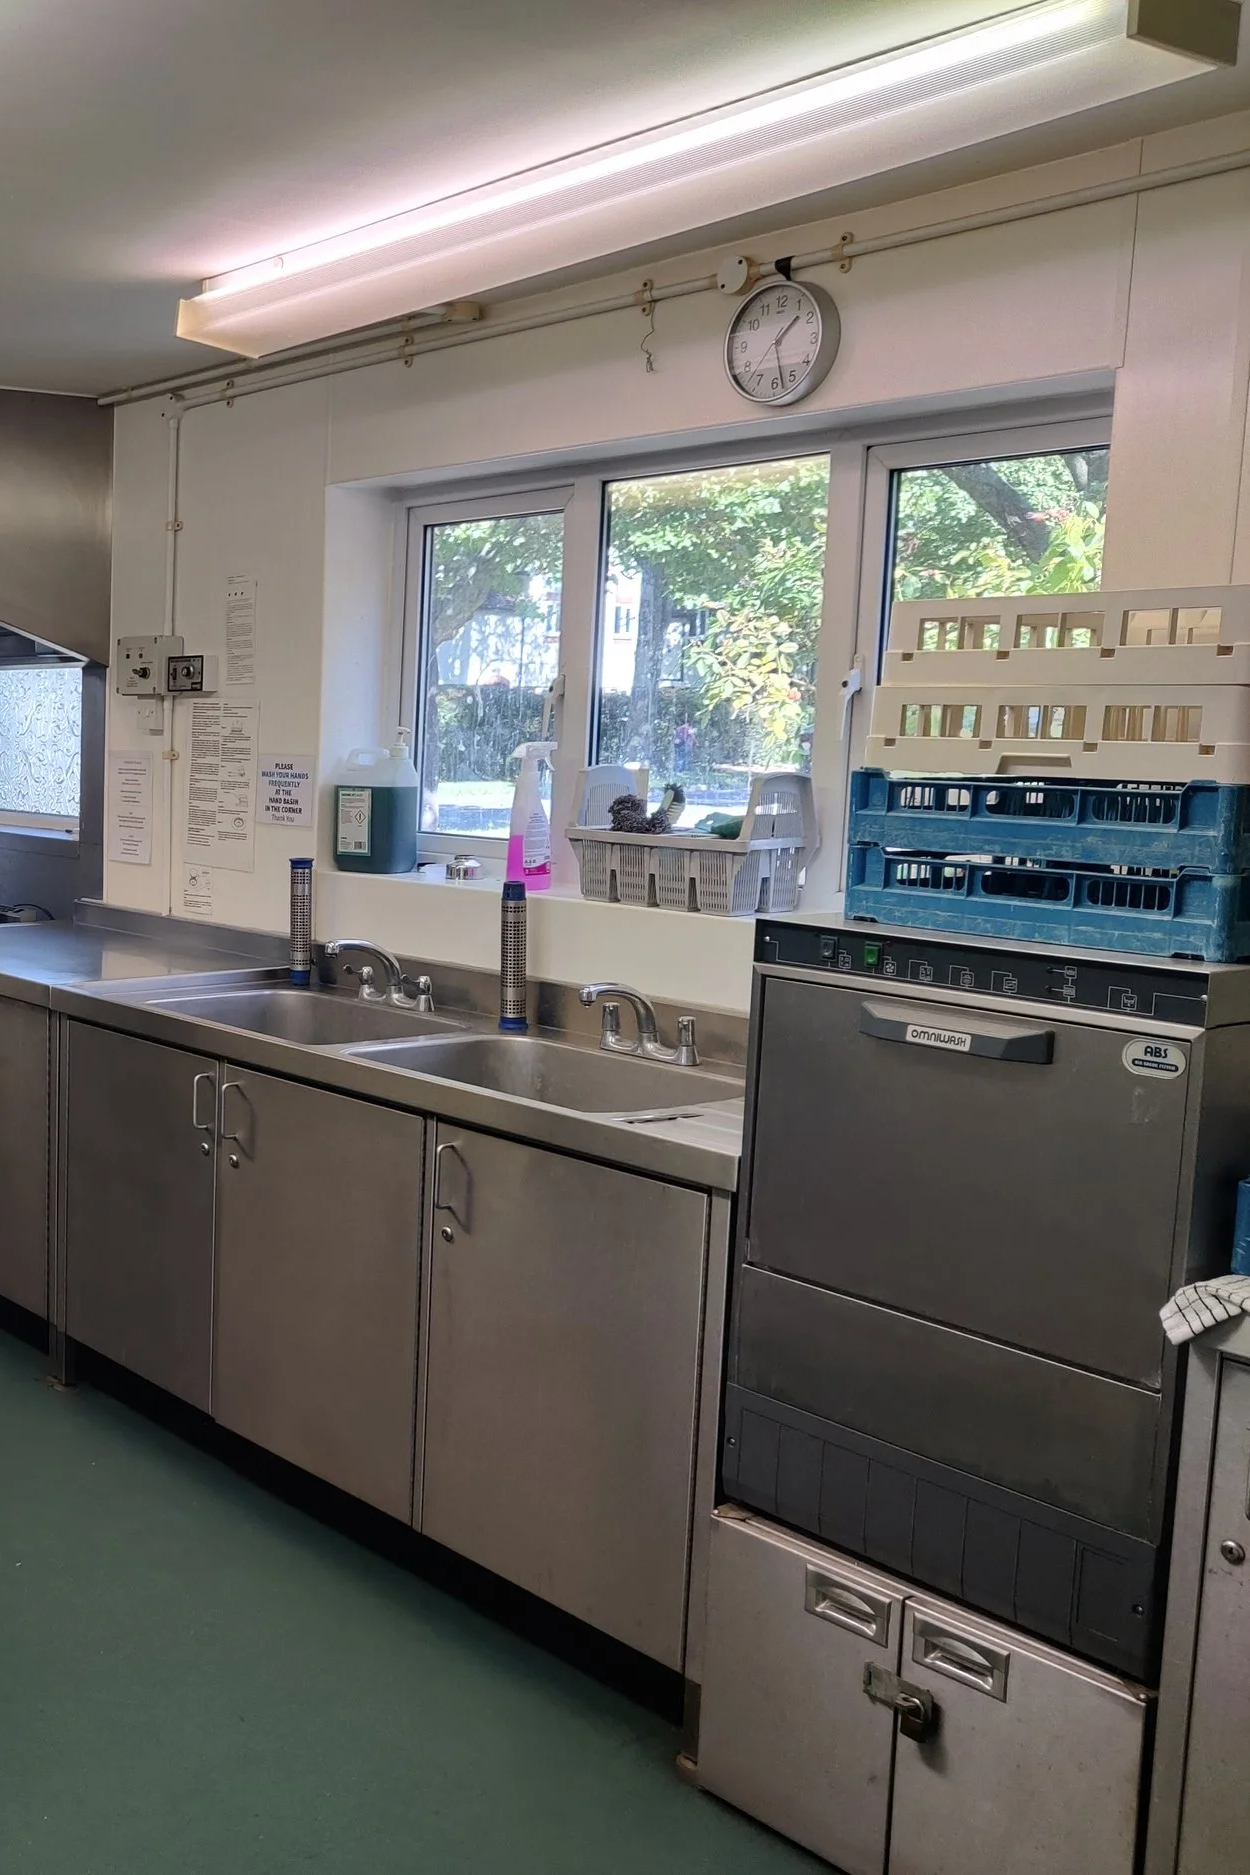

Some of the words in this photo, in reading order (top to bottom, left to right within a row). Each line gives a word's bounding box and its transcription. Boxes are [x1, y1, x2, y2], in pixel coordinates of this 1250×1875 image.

[776, 295, 788, 308] 12
[796, 299, 801, 311] 1
[760, 304, 770, 316] 11
[806, 312, 814, 324] 2
[749, 319, 760, 331] 10
[810, 332, 818, 345] 3
[740, 341, 748, 353] 9
[802, 353, 810, 366] 4
[744, 361, 751, 373] 8
[757, 374, 764, 387] 7
[788, 370, 796, 383] 5
[771, 378, 779, 390] 6
[276, 771, 290, 779] YOUR
[290, 772, 309, 780] HANDS
[268, 780, 301, 788] FREQUENTLY
[268, 797, 282, 805] HAND
[281, 807, 303, 815] CORNER
[271, 814, 285, 822] Thank
[911, 1029, 967, 1048] OMNIWASH
[1144, 1045, 1169, 1059] ABS
